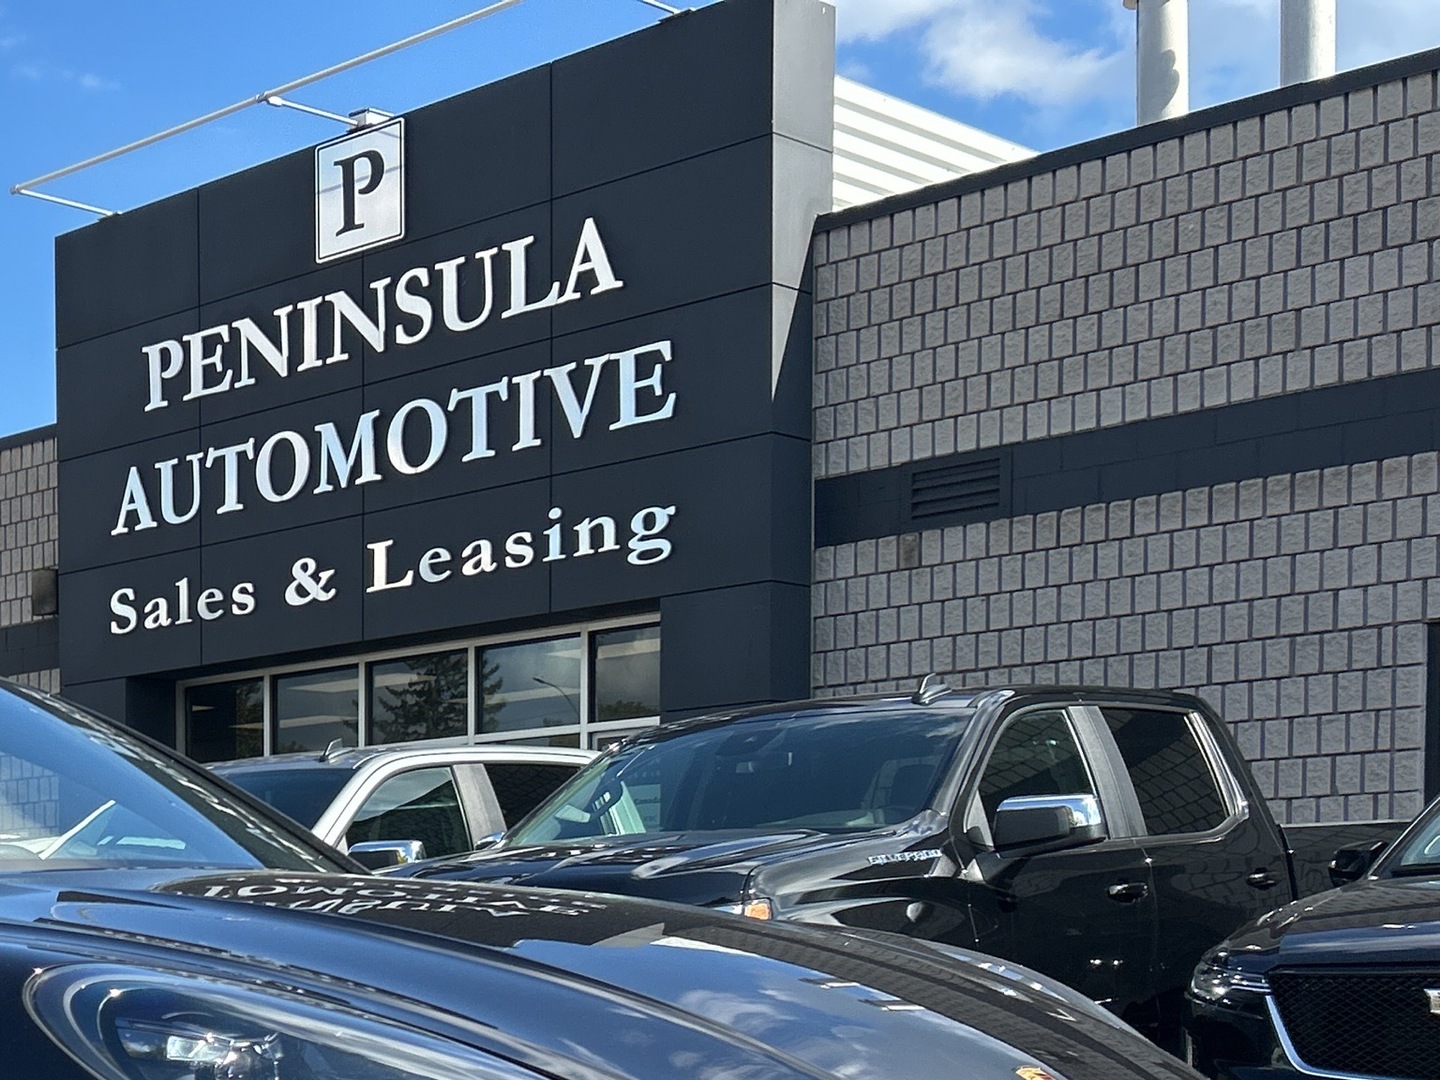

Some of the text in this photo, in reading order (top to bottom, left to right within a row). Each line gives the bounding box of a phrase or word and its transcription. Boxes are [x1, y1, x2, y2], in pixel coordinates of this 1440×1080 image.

[333, 149, 385, 236] P
[141, 216, 623, 412] PENINSULA
[110, 339, 678, 537] AUTOMOTIVE
[109, 504, 678, 636] Sales & Leasing
